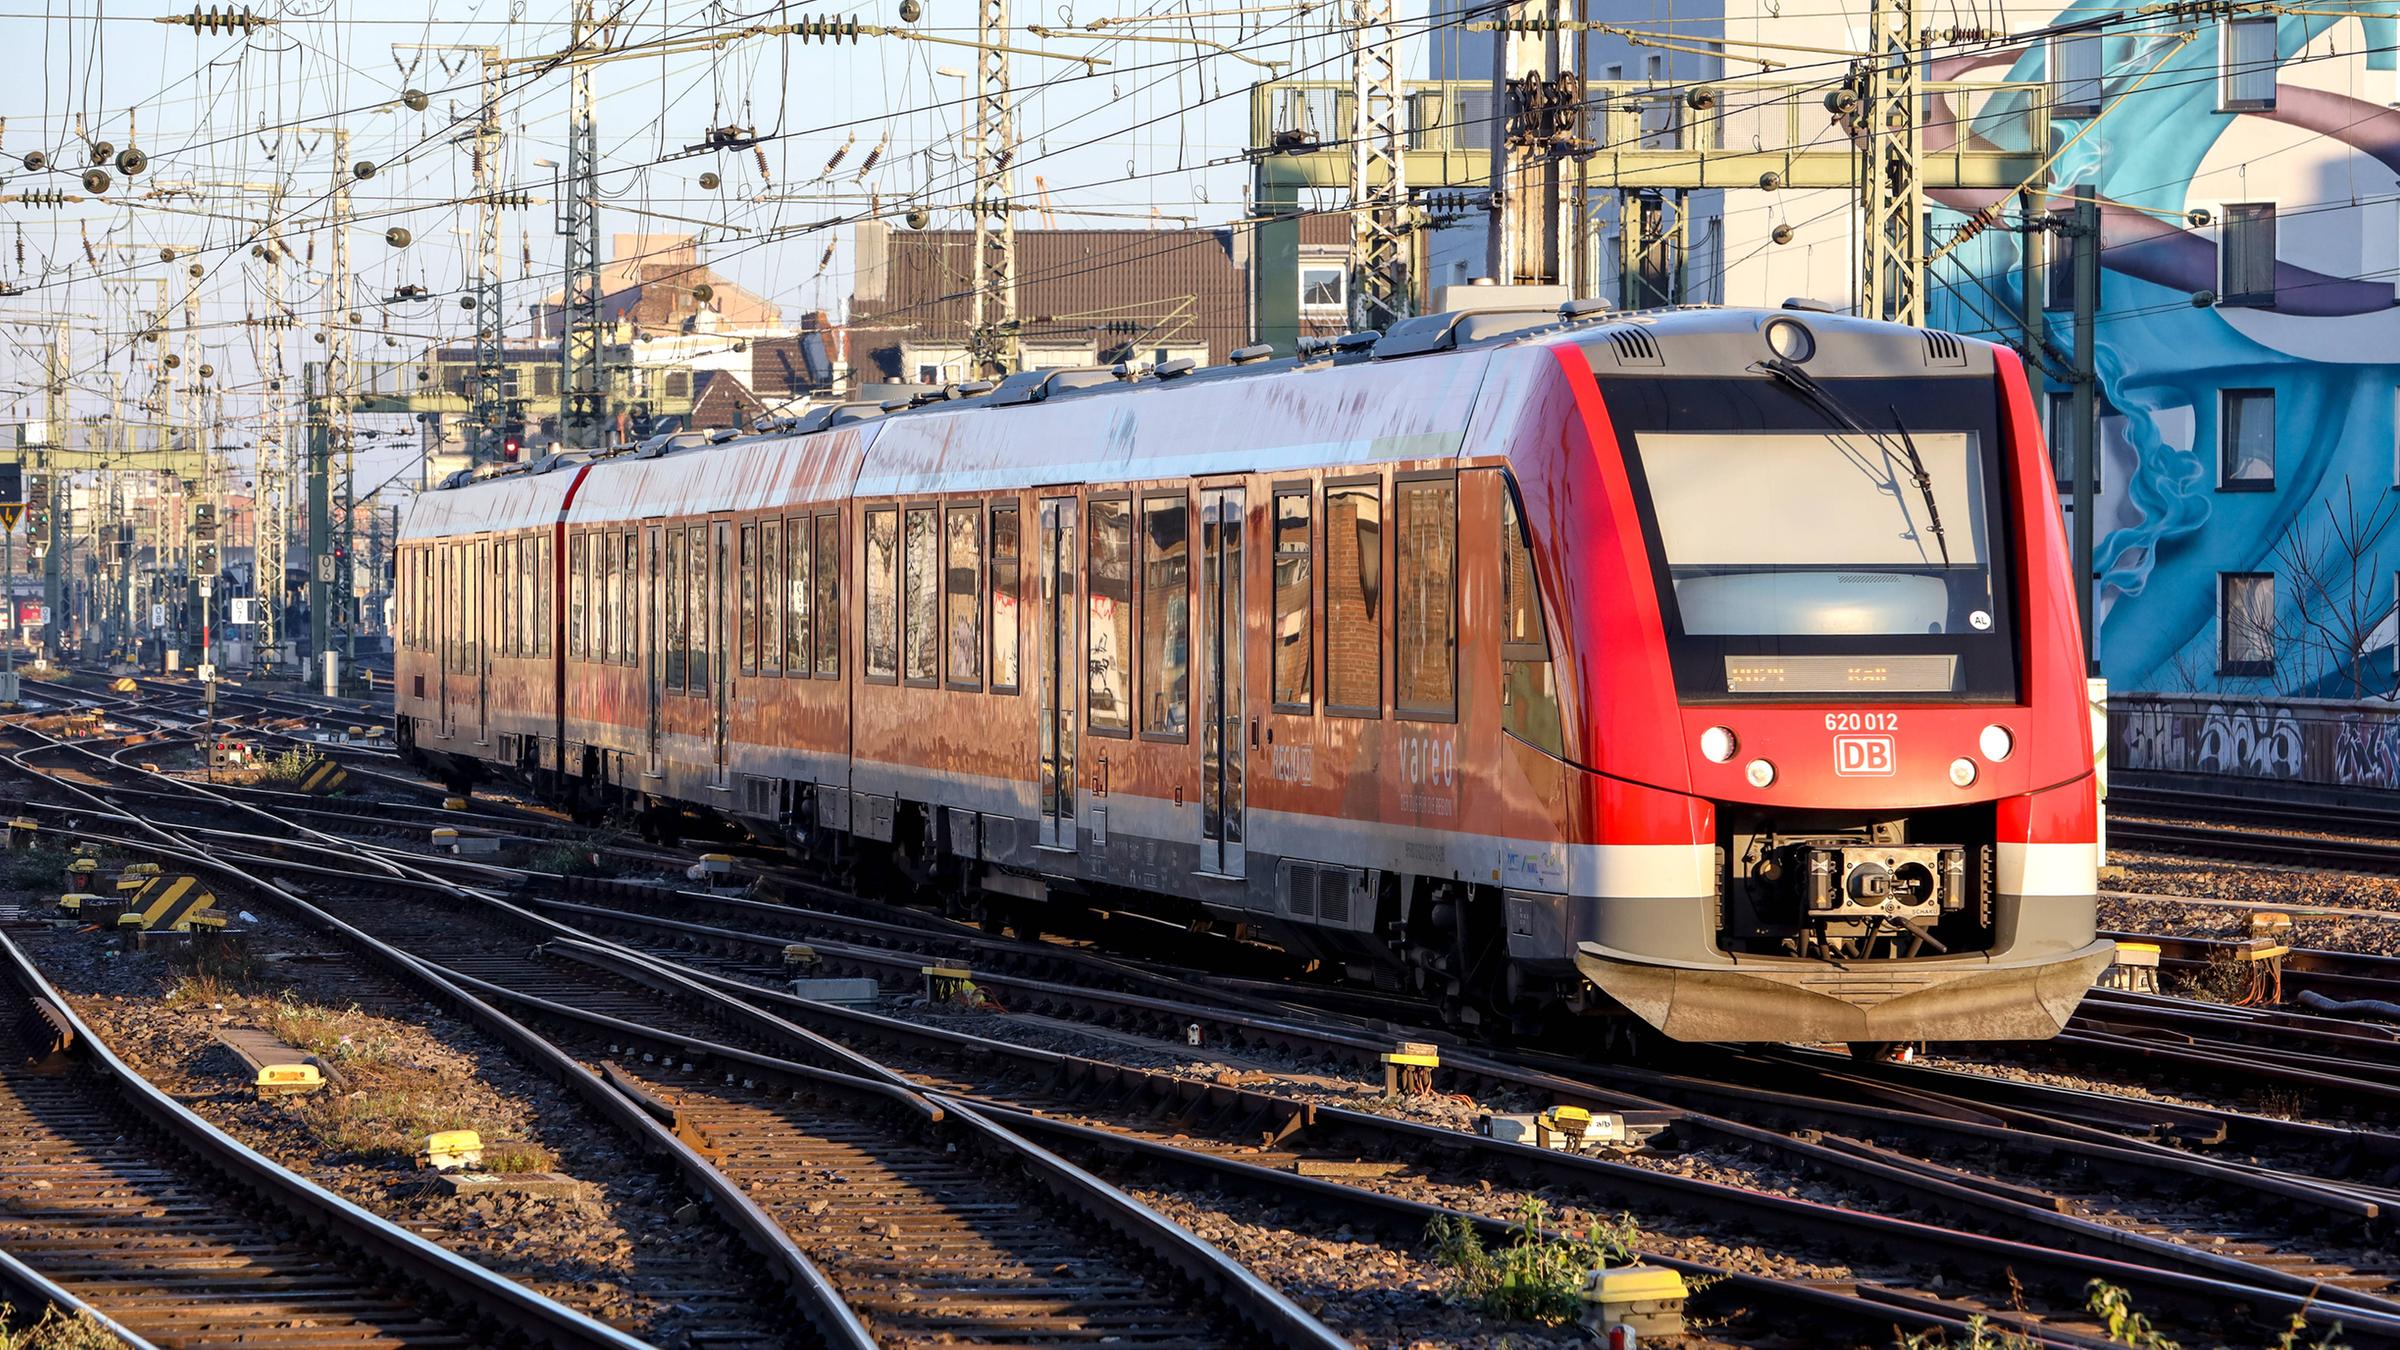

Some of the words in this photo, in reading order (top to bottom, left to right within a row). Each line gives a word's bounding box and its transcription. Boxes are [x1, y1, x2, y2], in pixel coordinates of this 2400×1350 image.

[1975, 616, 1987, 625] AL
[1825, 713, 1861, 731] 620
[1865, 713, 1898, 731] 012
[1273, 744, 1299, 782] REGIO
[1399, 736, 1453, 788] vareo
[1843, 742, 1888, 769] DB
[1596, 1120, 1611, 1128] a/b
